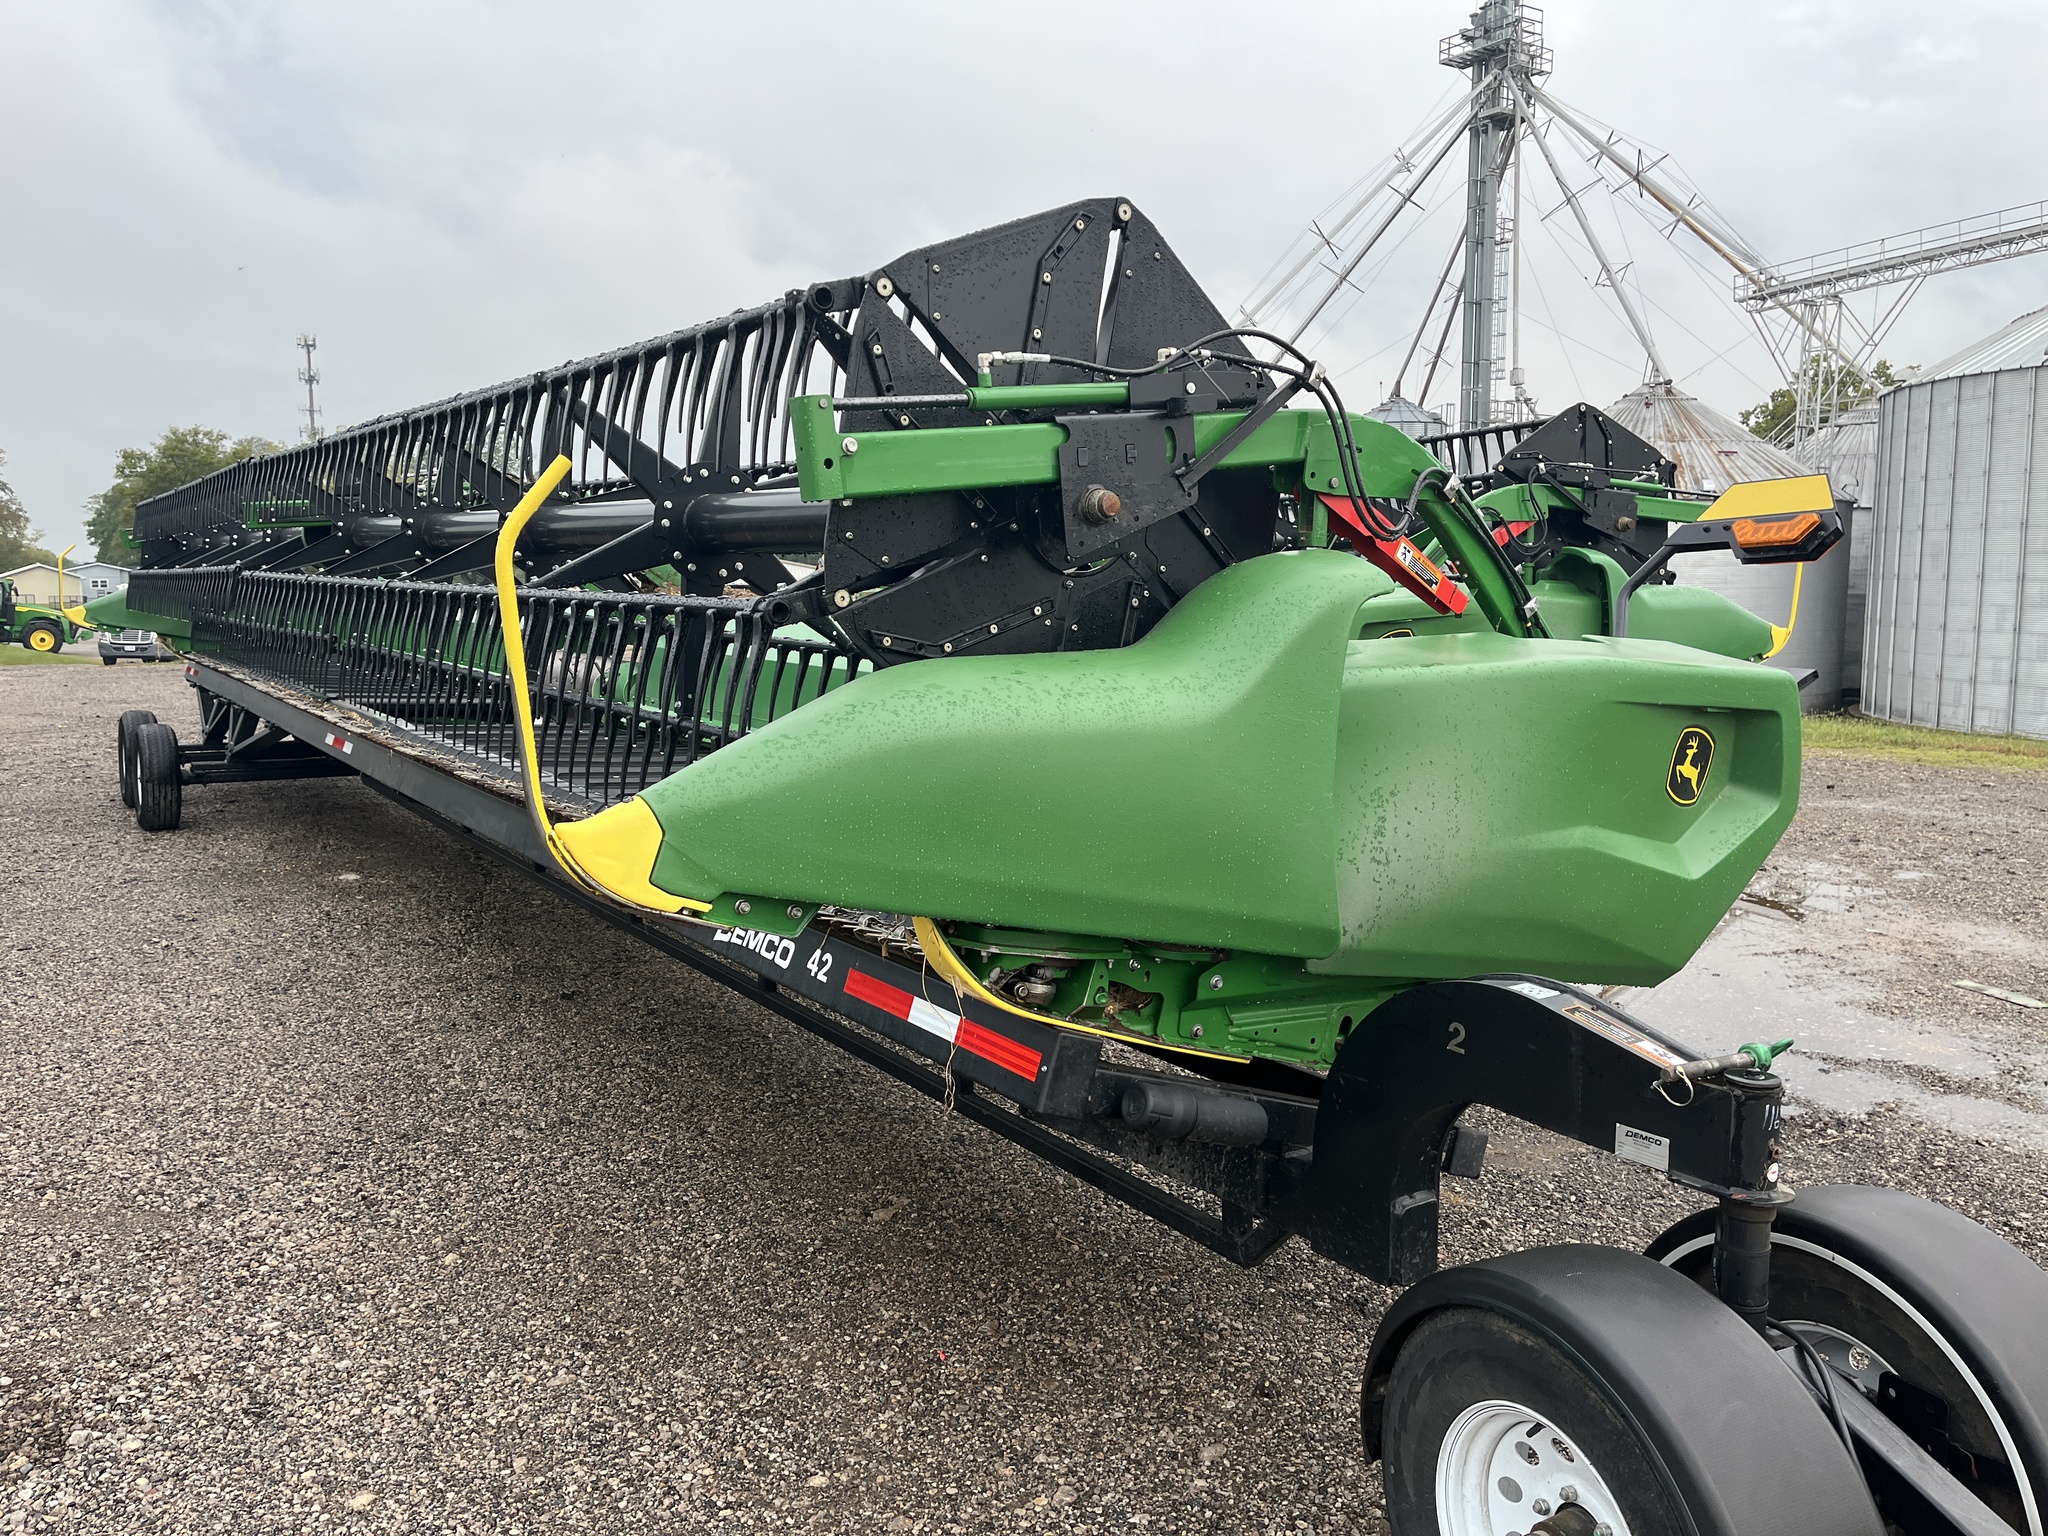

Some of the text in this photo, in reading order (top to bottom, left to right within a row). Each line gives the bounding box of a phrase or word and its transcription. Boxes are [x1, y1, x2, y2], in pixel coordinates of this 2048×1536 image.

[806, 948, 833, 983] 42
[1446, 1022, 1466, 1055] 2
[1625, 1130, 1662, 1146] DEMCO
